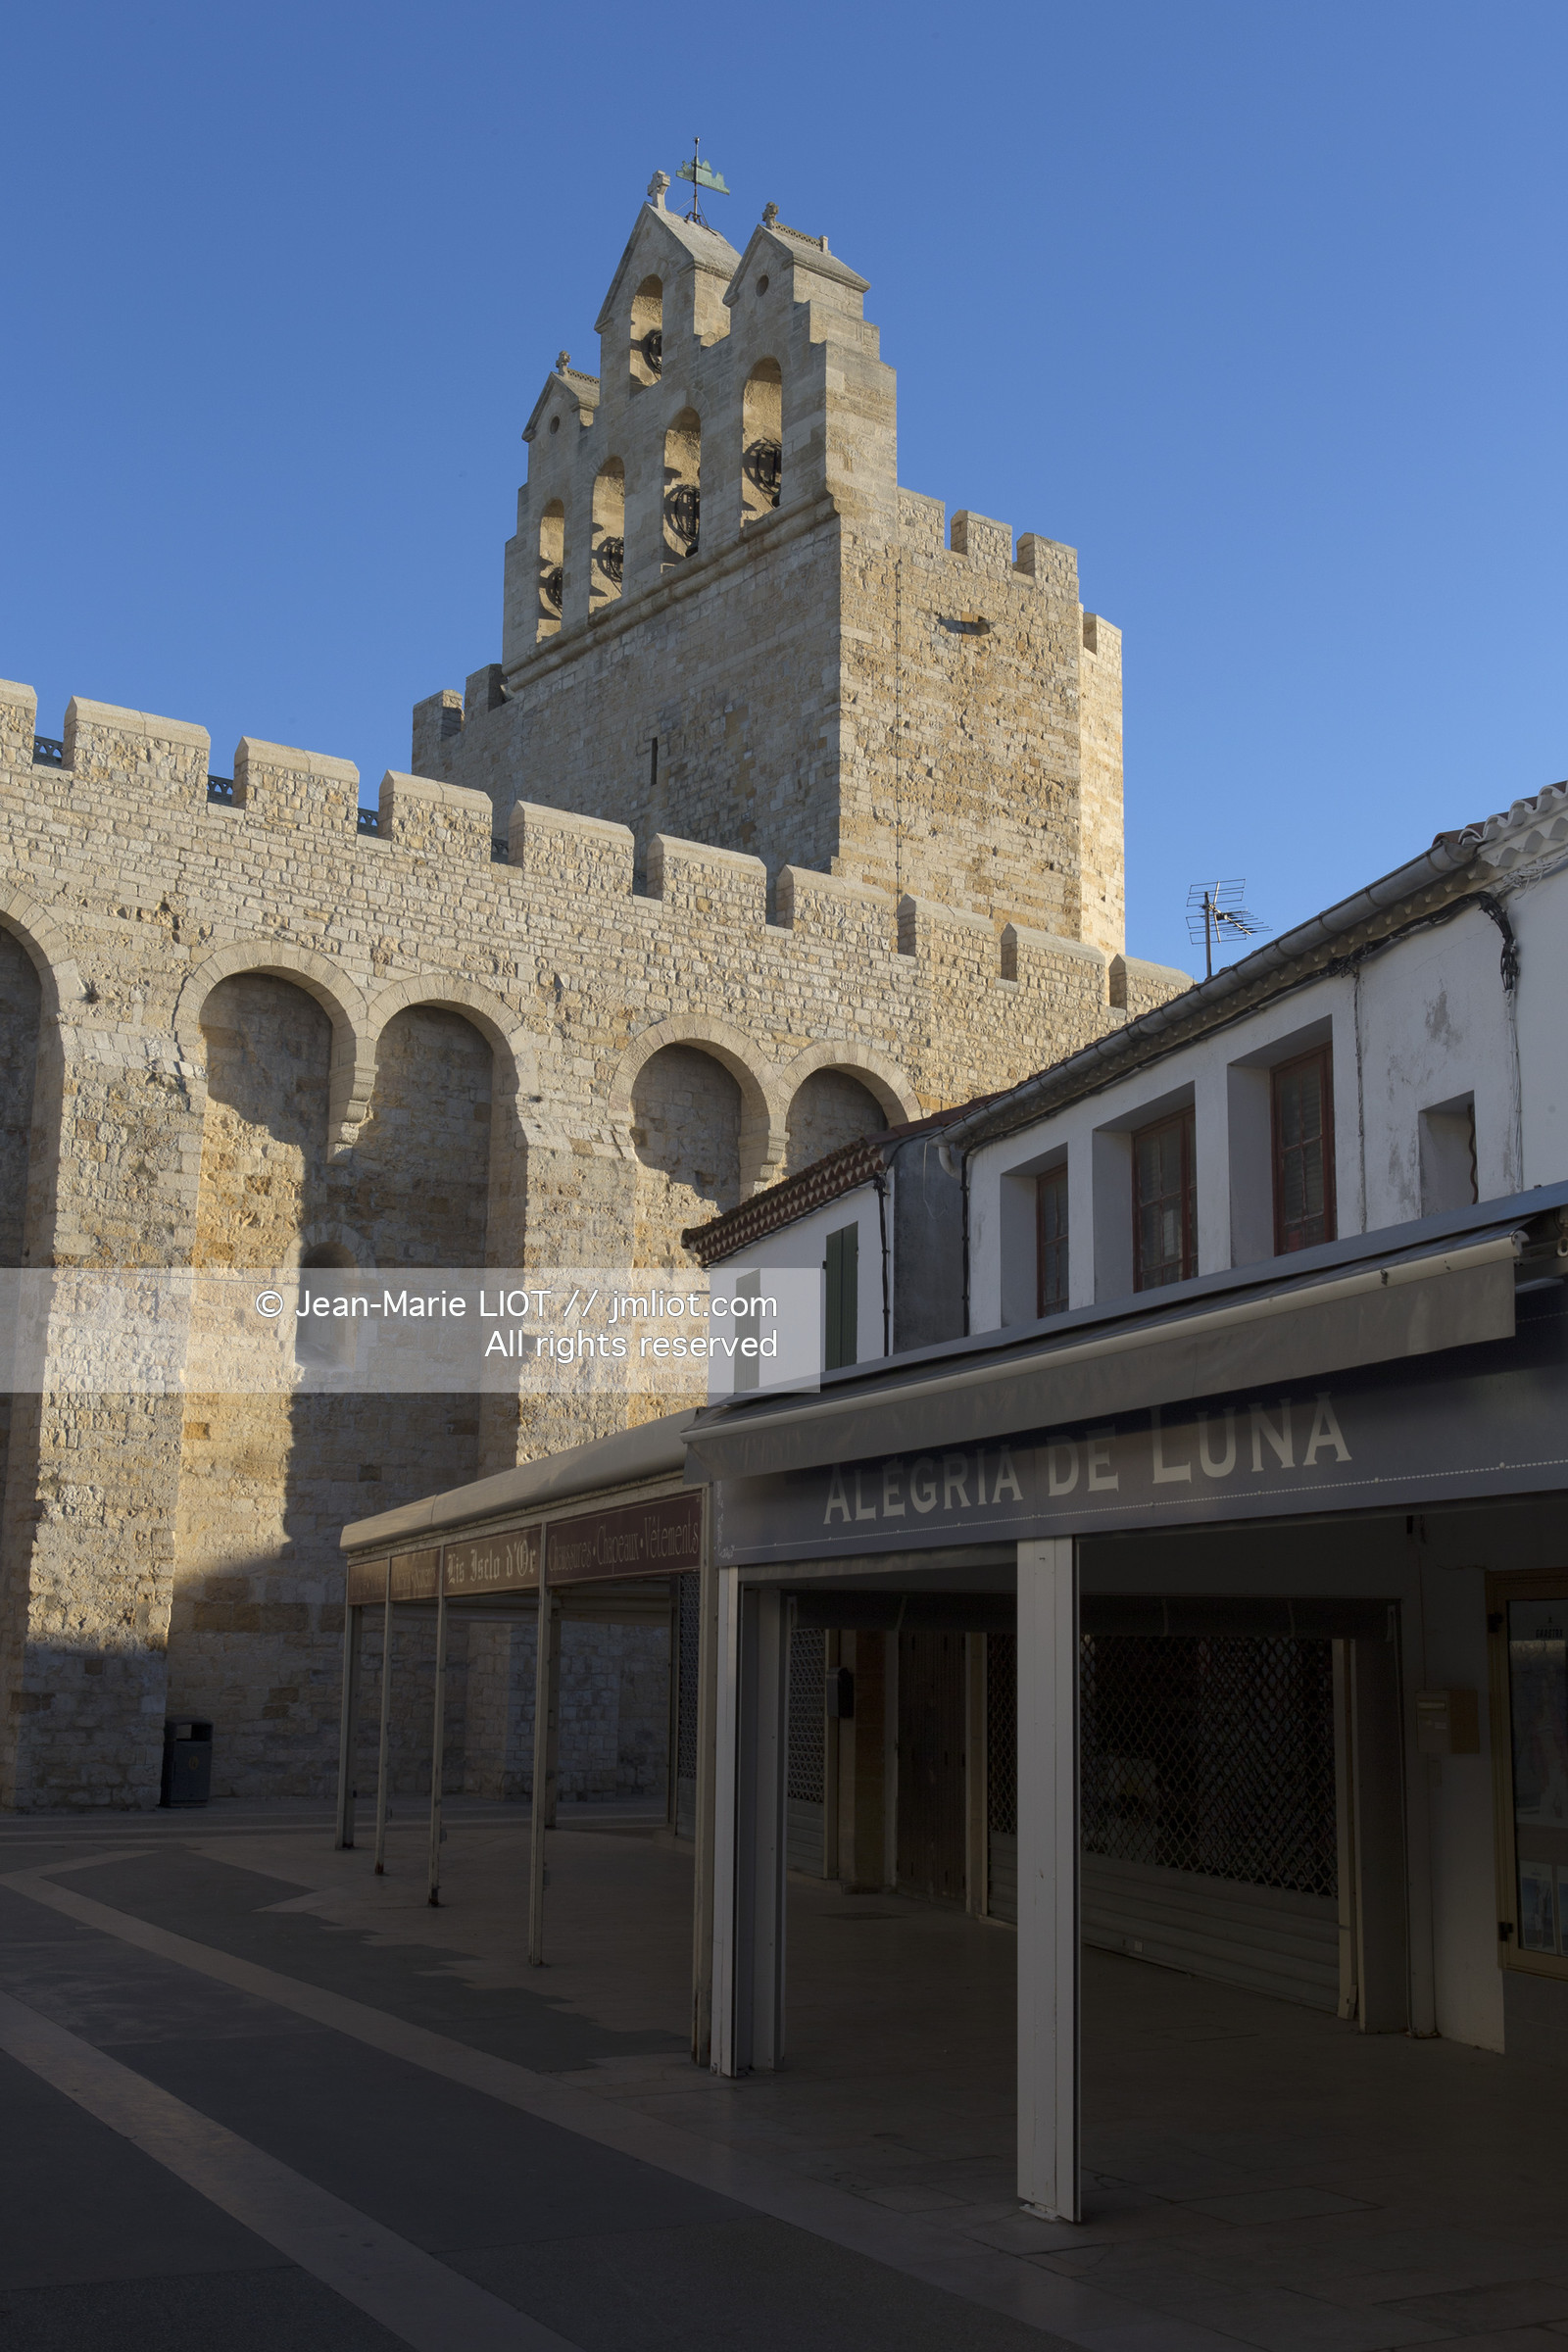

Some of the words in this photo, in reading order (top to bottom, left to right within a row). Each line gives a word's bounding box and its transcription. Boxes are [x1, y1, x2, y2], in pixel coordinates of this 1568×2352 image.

[1046, 1425, 1119, 1497] DE
[1148, 1391, 1352, 1485] LUNA
[644, 1509, 699, 1559] Vêtements
